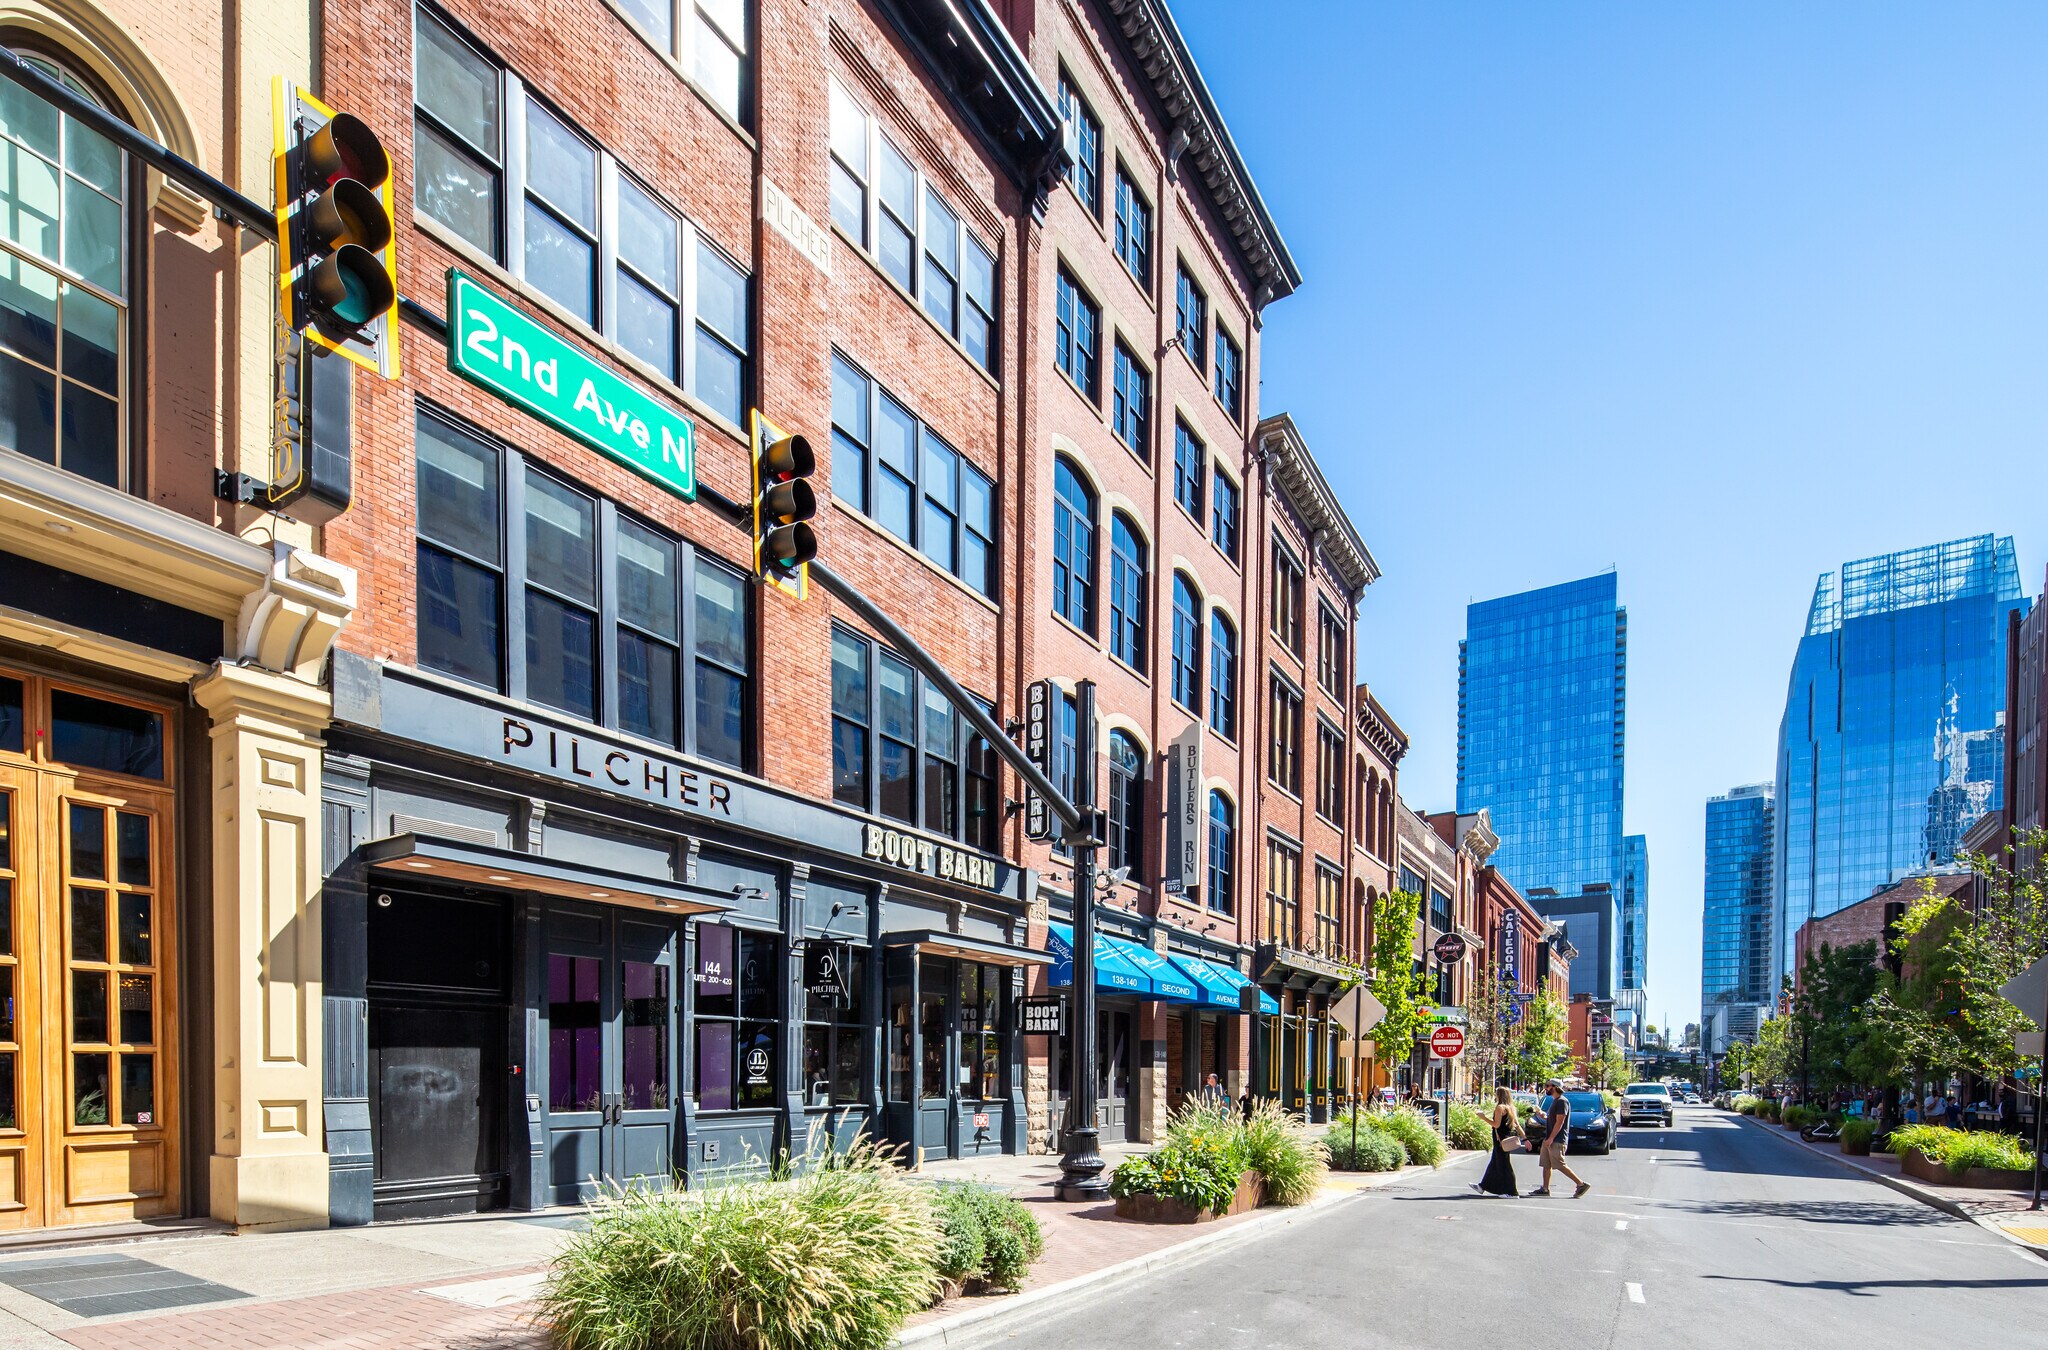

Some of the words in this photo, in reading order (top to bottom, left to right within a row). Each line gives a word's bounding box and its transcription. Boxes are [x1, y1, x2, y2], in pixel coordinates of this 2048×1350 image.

[766, 186, 829, 269] PILCHER
[466, 308, 559, 398] 2nd
[572, 377, 651, 449] Ave
[661, 425, 687, 473] N
[1030, 685, 1044, 757] BOOT
[503, 717, 731, 816] PILCHER
[1186, 745, 1196, 825] BUTLERS
[866, 822, 933, 871] BOOT
[939, 846, 996, 889] BARN
[1184, 841, 1194, 874] RUN
[705, 960, 721, 975] 144
[1504, 913, 1514, 975] CATEGOR
[811, 984, 840, 994] PILCHER
[1025, 1005, 1059, 1018] BOOT
[1112, 974, 1137, 987] 138-140
[1161, 983, 1190, 996] SECOND
[1216, 994, 1239, 1005] AVENUE
[1259, 1002, 1272, 1011] ORTH
[1025, 1018, 1059, 1031] BARN
[975, 1115, 987, 1125] FDC
